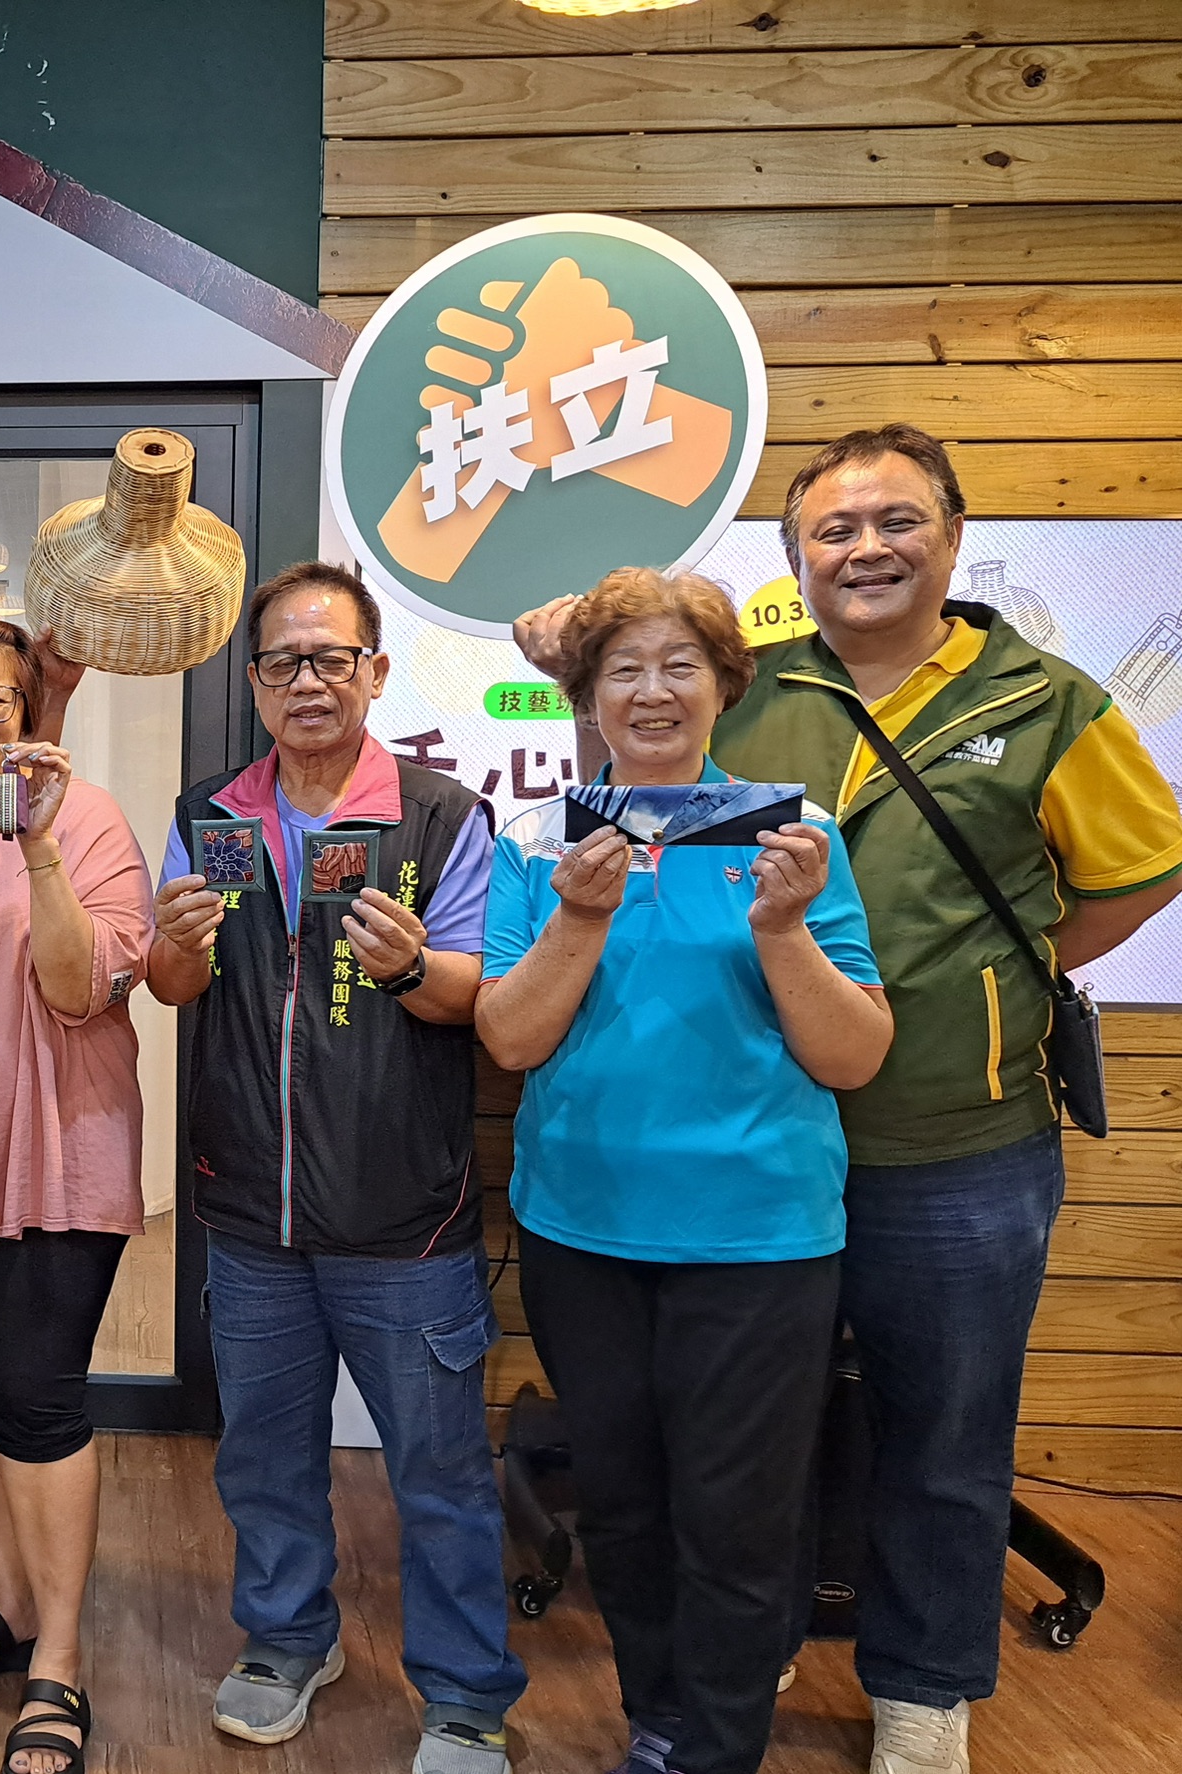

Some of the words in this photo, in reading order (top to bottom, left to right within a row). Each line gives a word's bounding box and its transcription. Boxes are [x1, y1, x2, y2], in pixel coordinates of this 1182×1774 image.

[419, 335, 673, 523] 扶立
[752, 601, 812, 628] 10.3
[329, 939, 354, 1027] 服務團隊
